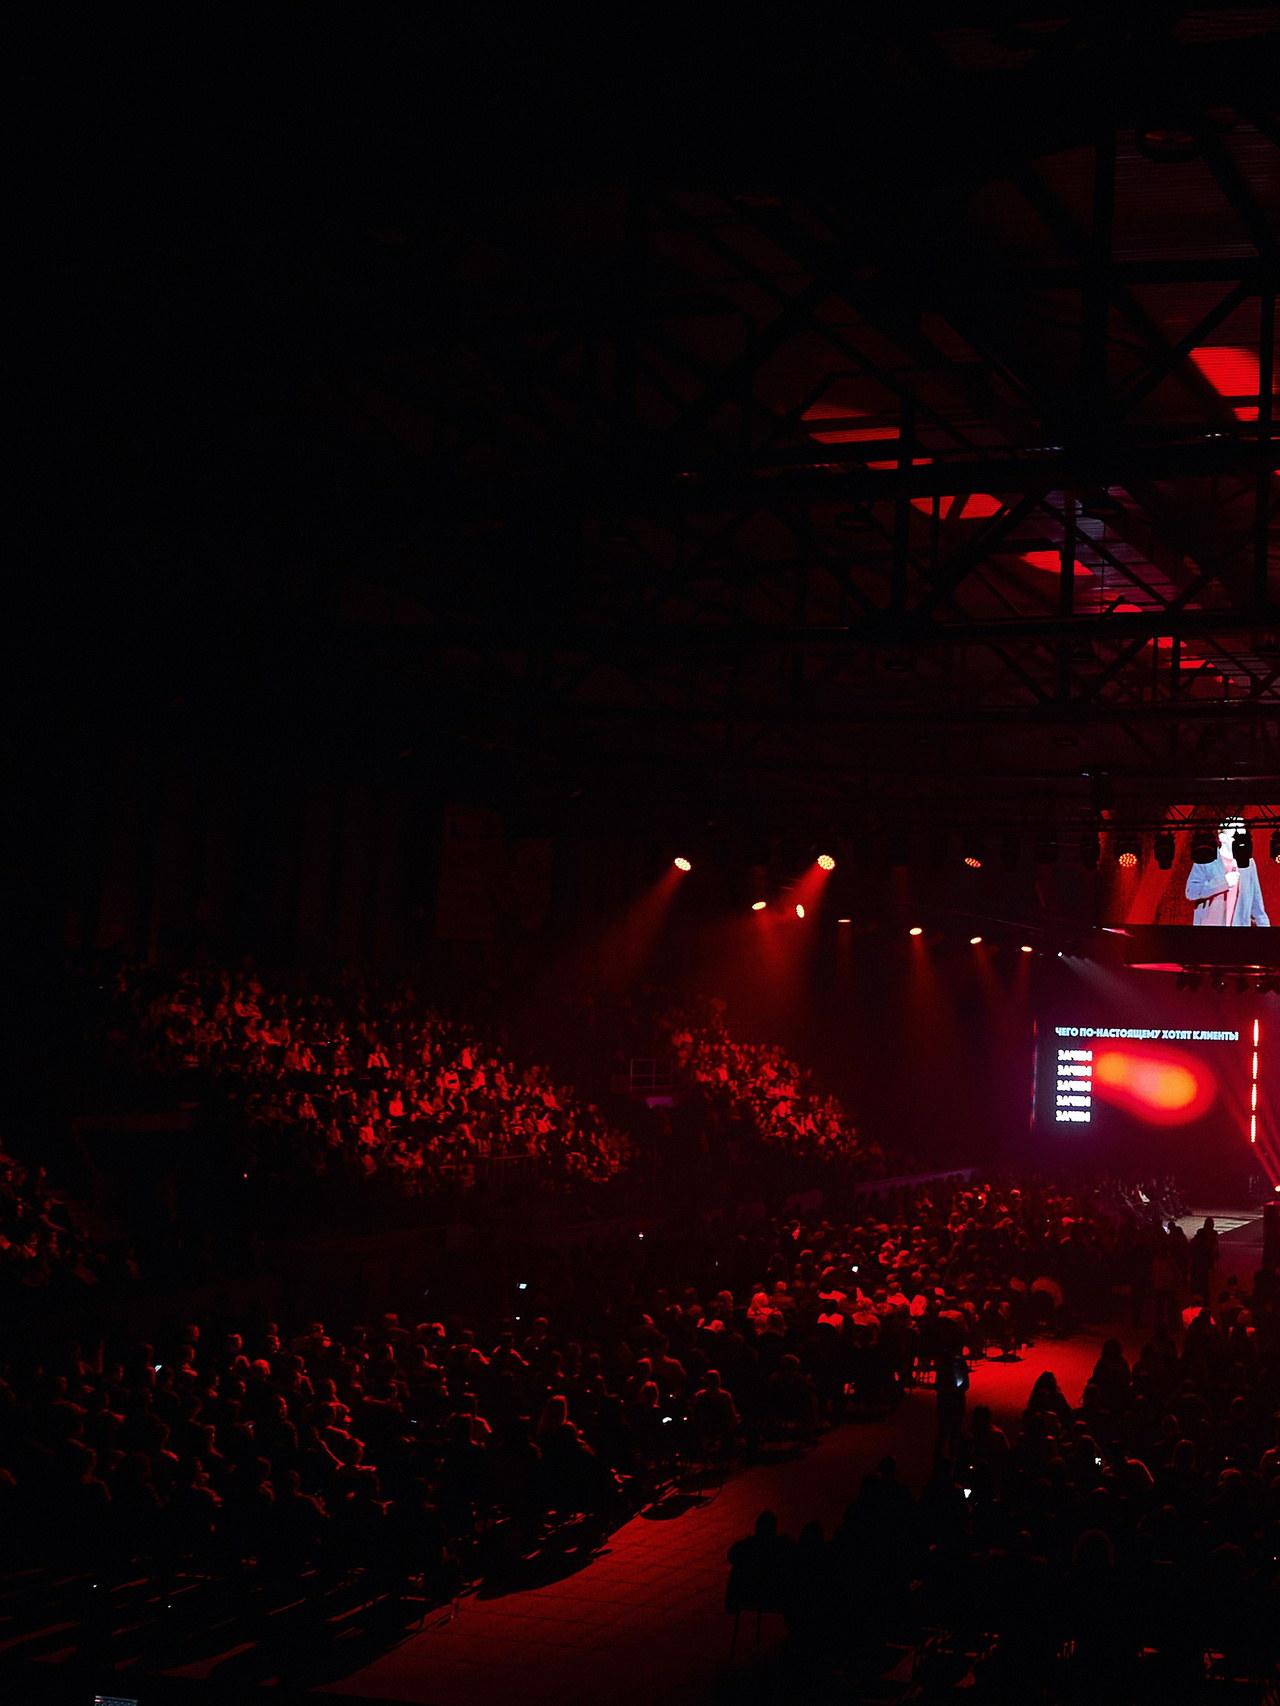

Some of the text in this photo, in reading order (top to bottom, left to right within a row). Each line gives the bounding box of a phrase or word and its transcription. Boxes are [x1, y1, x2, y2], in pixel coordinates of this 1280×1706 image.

[1055, 1027, 1238, 1040] ЧЕГО ПО-НАСТОЯЩЕМУ ХОТЯТ КЛИЕНТЫ
